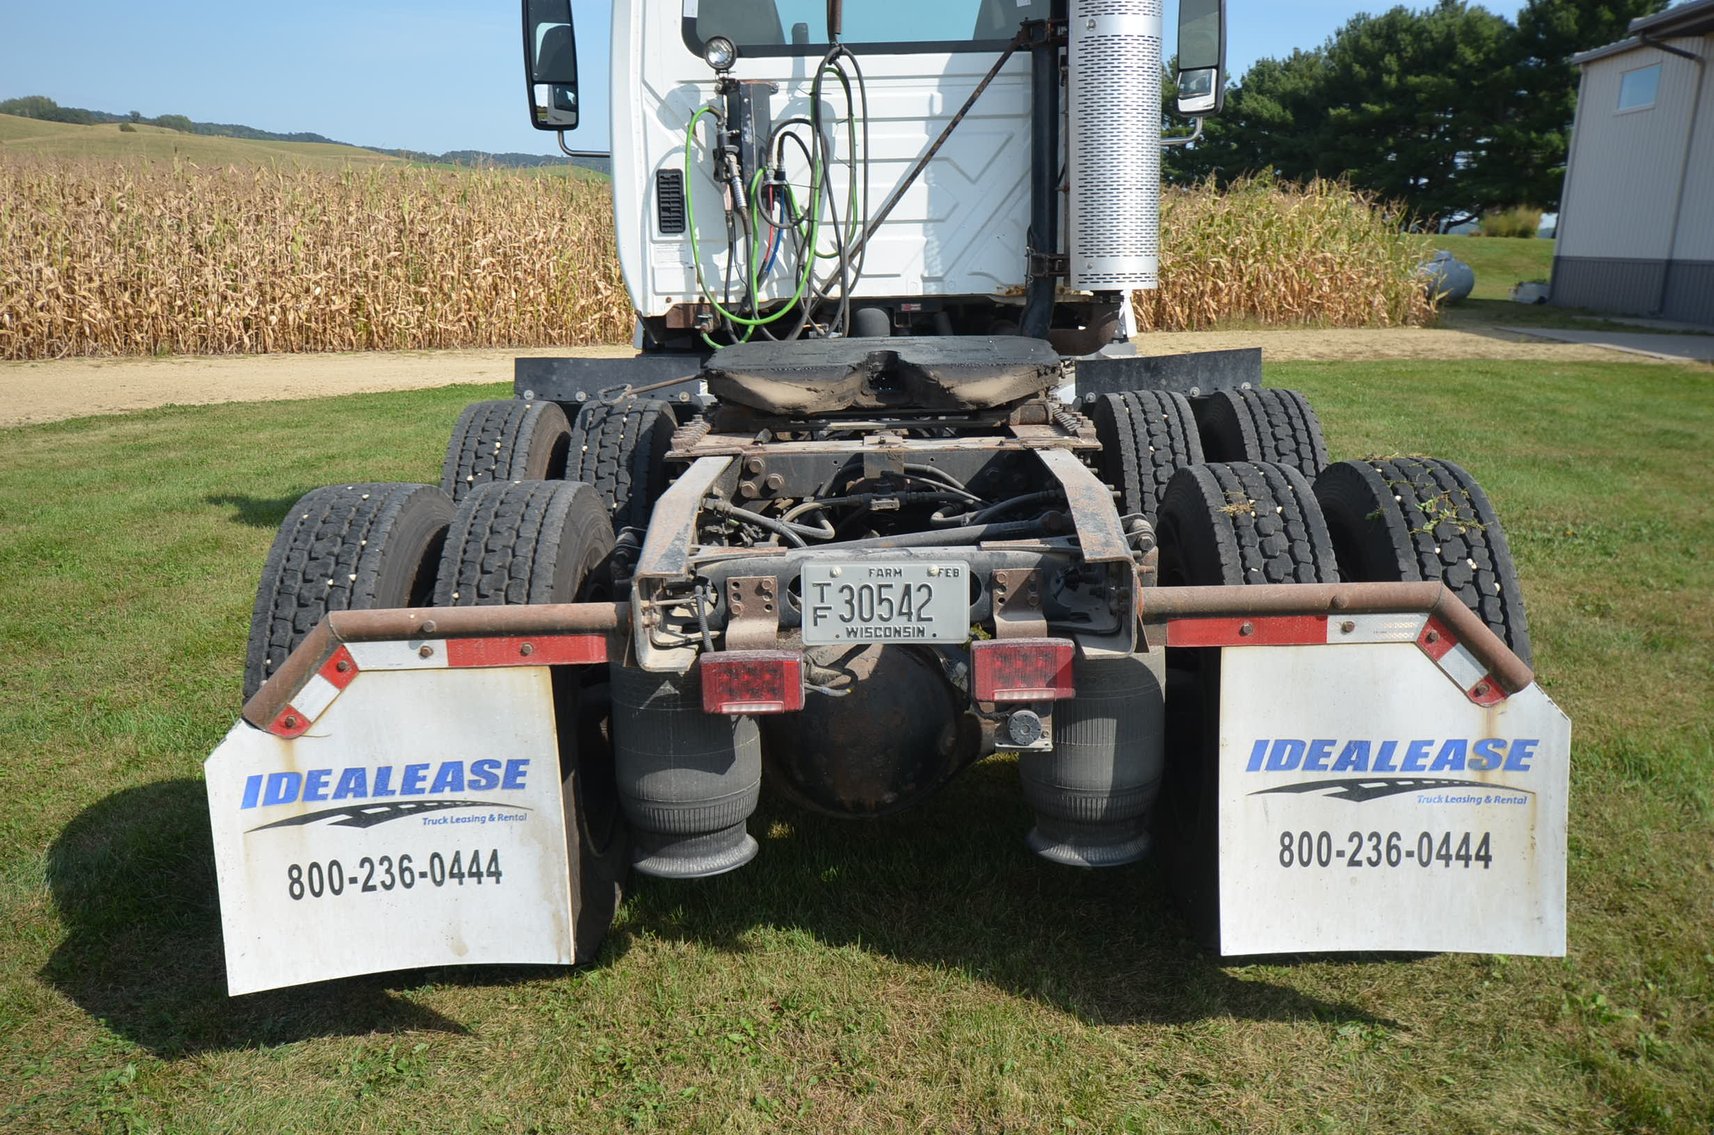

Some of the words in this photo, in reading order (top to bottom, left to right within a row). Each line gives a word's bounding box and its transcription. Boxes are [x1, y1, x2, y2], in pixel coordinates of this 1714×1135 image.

[868, 568, 902, 578] FARM
[938, 568, 960, 578] FEB
[838, 583, 934, 623] 30542
[845, 626, 926, 639] WISCONSIN
[1245, 738, 1540, 772] IDEALEASE
[240, 758, 531, 810] IDEALEASE
[1417, 795, 1443, 804] Truck
[1445, 795, 1483, 806] Leasing
[1484, 796, 1492, 804] &
[1494, 796, 1528, 805] Rental
[422, 816, 449, 826] Truck
[450, 814, 486, 825] Leasing
[488, 814, 496, 822] &
[497, 813, 528, 822] Rental
[1279, 831, 1493, 869] 800-236-0444
[287, 848, 503, 901] 800-236-0444
